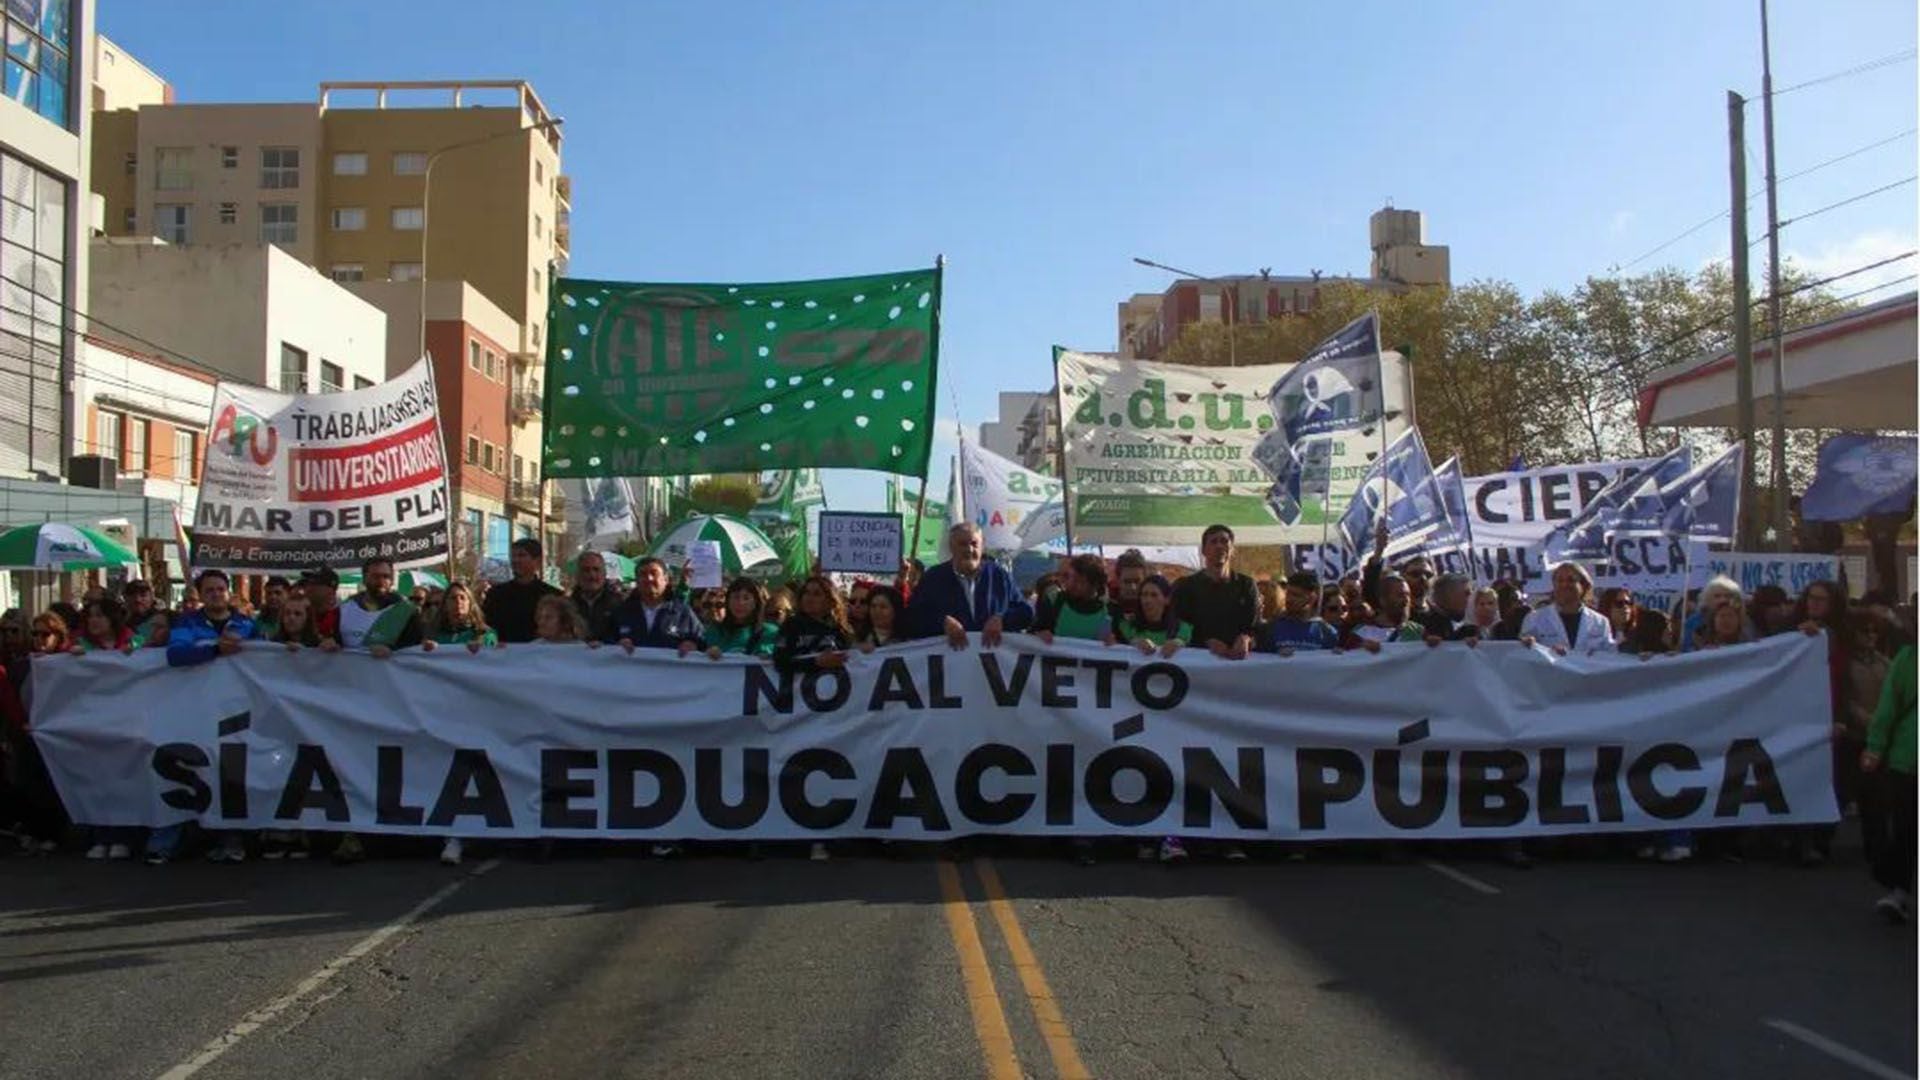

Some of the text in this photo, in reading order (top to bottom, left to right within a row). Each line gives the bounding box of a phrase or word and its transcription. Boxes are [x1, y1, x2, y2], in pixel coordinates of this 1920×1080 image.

[1075, 378, 1274, 431] a.d.u.
[202, 486, 447, 533] MAR DEL PLAT
[199, 543, 225, 559] Por
[228, 545, 243, 560] la
[358, 543, 378, 559] de
[380, 542, 393, 557] la
[397, 537, 430, 553] Clase
[743, 652, 1190, 716] NO AL VETO
[152, 711, 1792, 832] SÍ A LA EDUCACIÓN PÚBLICA
